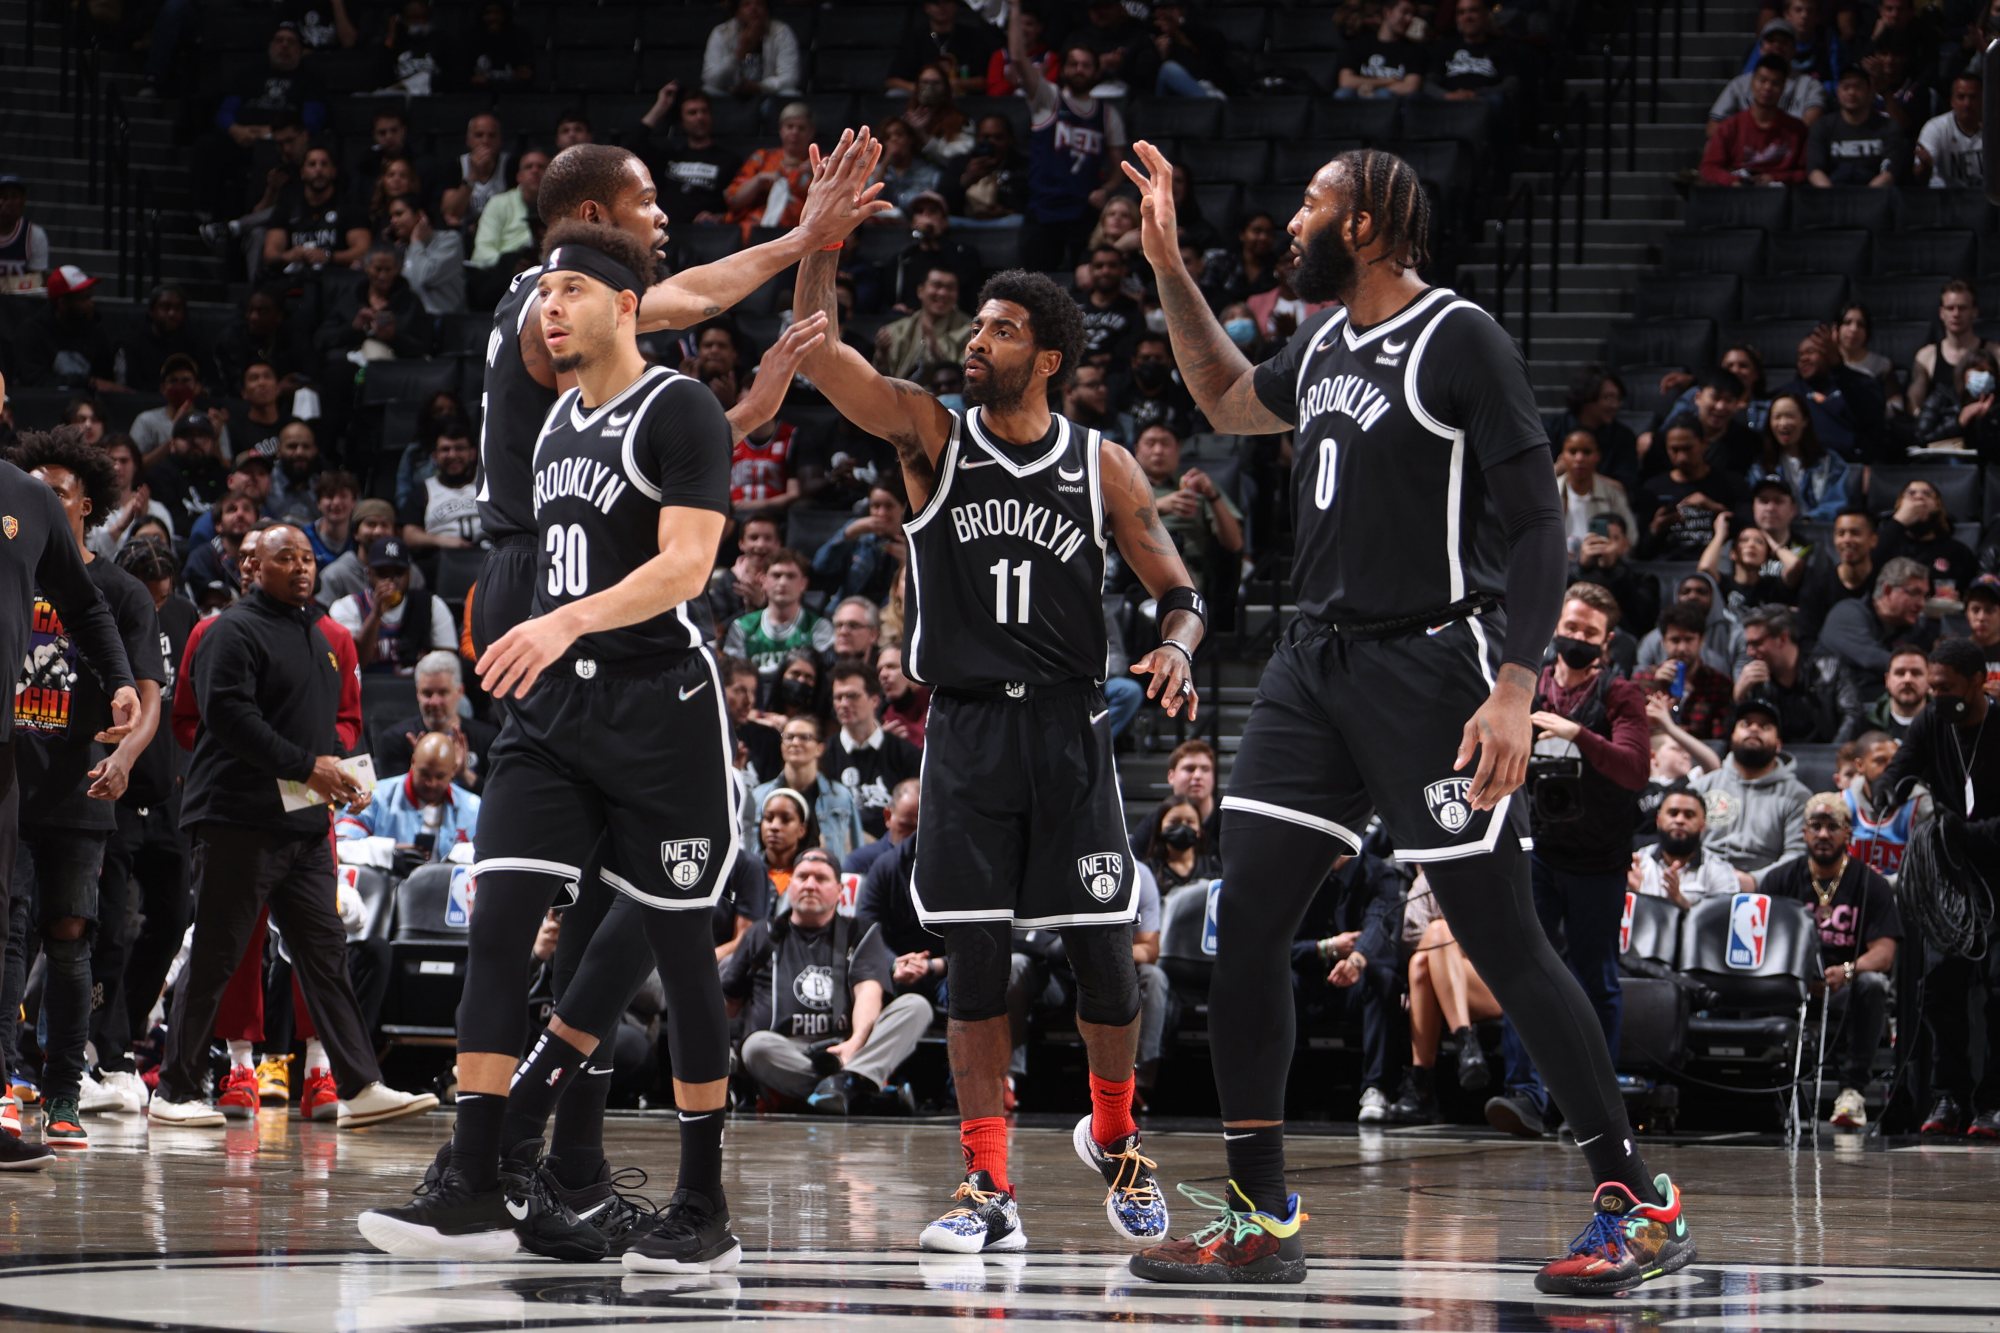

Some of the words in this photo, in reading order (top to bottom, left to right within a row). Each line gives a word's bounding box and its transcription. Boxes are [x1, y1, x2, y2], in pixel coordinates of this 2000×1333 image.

[1299, 374, 1392, 433] BROOKLYN
[1057, 484, 1083, 494] Webull
[1315, 437, 1338, 511] 0
[546, 523, 589, 597] 30
[951, 499, 1087, 564] BROOKLYN
[989, 558, 1032, 624] 11
[664, 841, 708, 863] NETS
[1081, 854, 1121, 878] NETS
[1731, 949, 1751, 963] NBA
